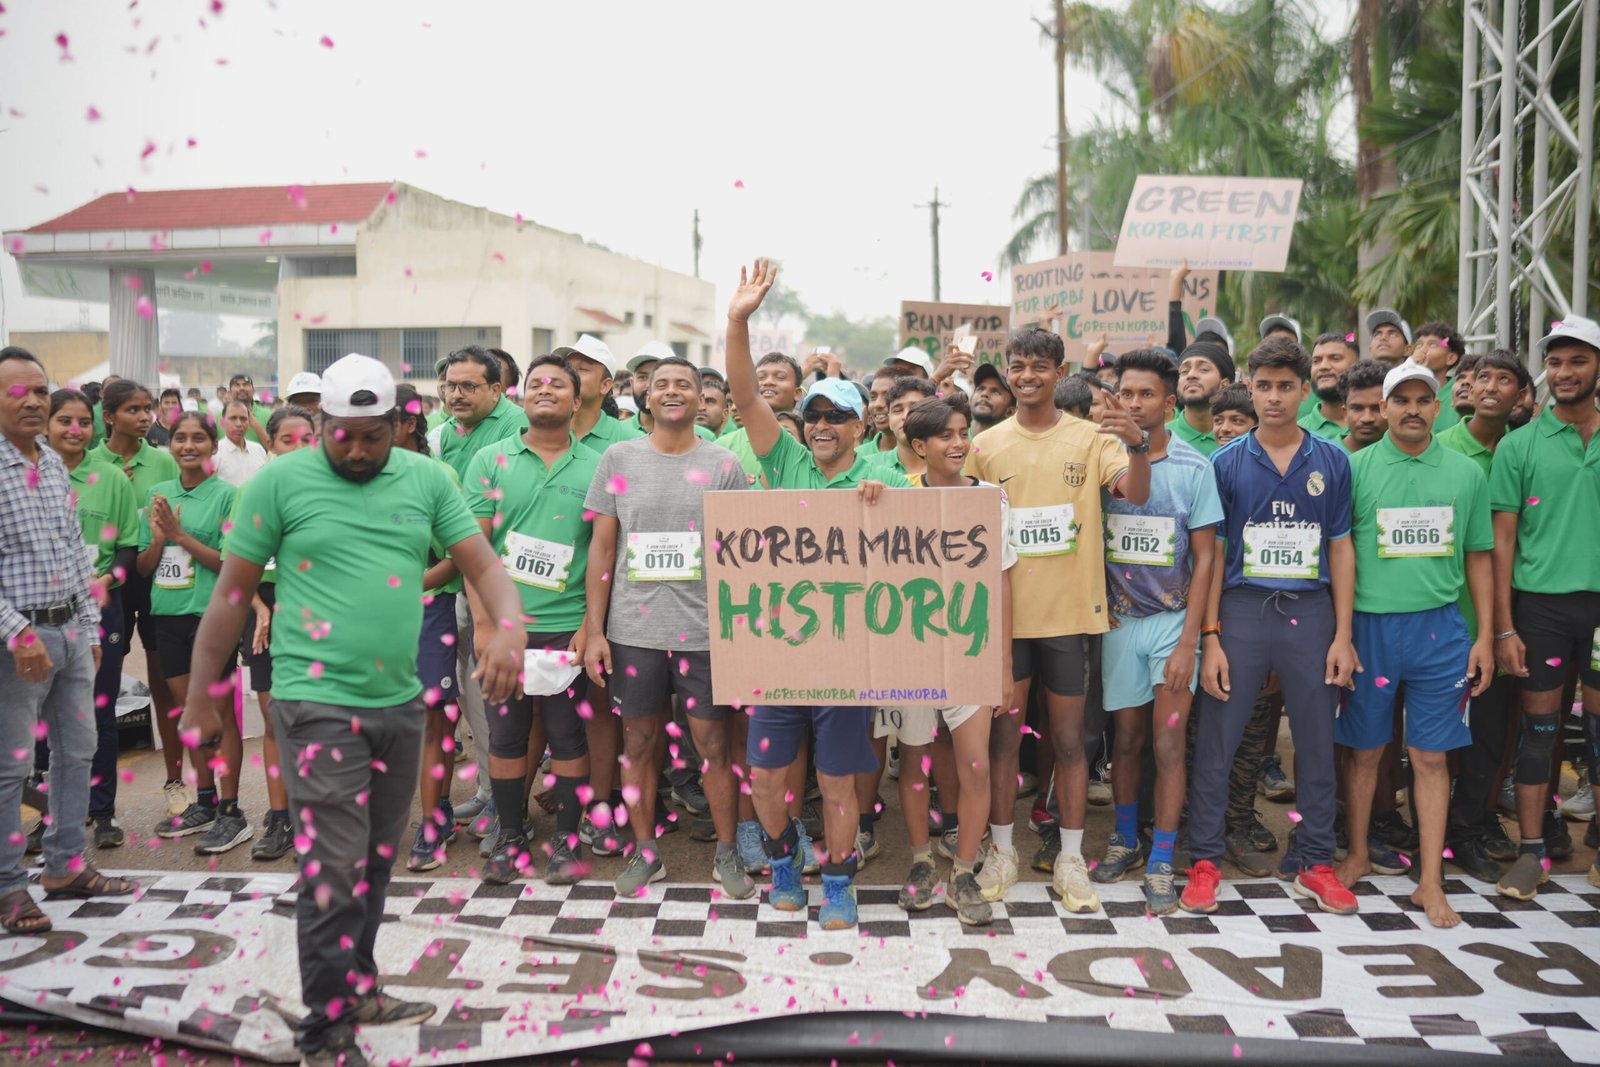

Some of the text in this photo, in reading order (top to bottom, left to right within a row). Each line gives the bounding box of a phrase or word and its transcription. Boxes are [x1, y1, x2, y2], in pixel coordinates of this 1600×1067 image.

[1135, 185, 1295, 219] GREEN
[1126, 221, 1287, 244] KORBA FIRST
[1014, 263, 1084, 292] ROOTING
[1014, 298, 1040, 314] FOR
[1091, 288, 1156, 315] LOVE
[905, 310, 954, 334] RUN
[1083, 320, 1125, 332] GREEN
[1127, 319, 1165, 332] KORBA
[1271, 500, 1296, 518] Fly
[1020, 526, 1061, 545] 0145
[1121, 535, 1160, 553] 0152
[1392, 528, 1440, 545] 0666
[715, 524, 988, 569] KORBA MAKES
[1260, 548, 1304, 566] 0154
[515, 555, 555, 577] 0167
[645, 552, 685, 569] 0170
[718, 577, 989, 658] HISTORY
[764, 687, 948, 701] #GREENKORBA #CLEANKORBA
[876, 708, 902, 729] 10
[378, 936, 748, 999] SET
[917, 942, 1600, 1000] READY
